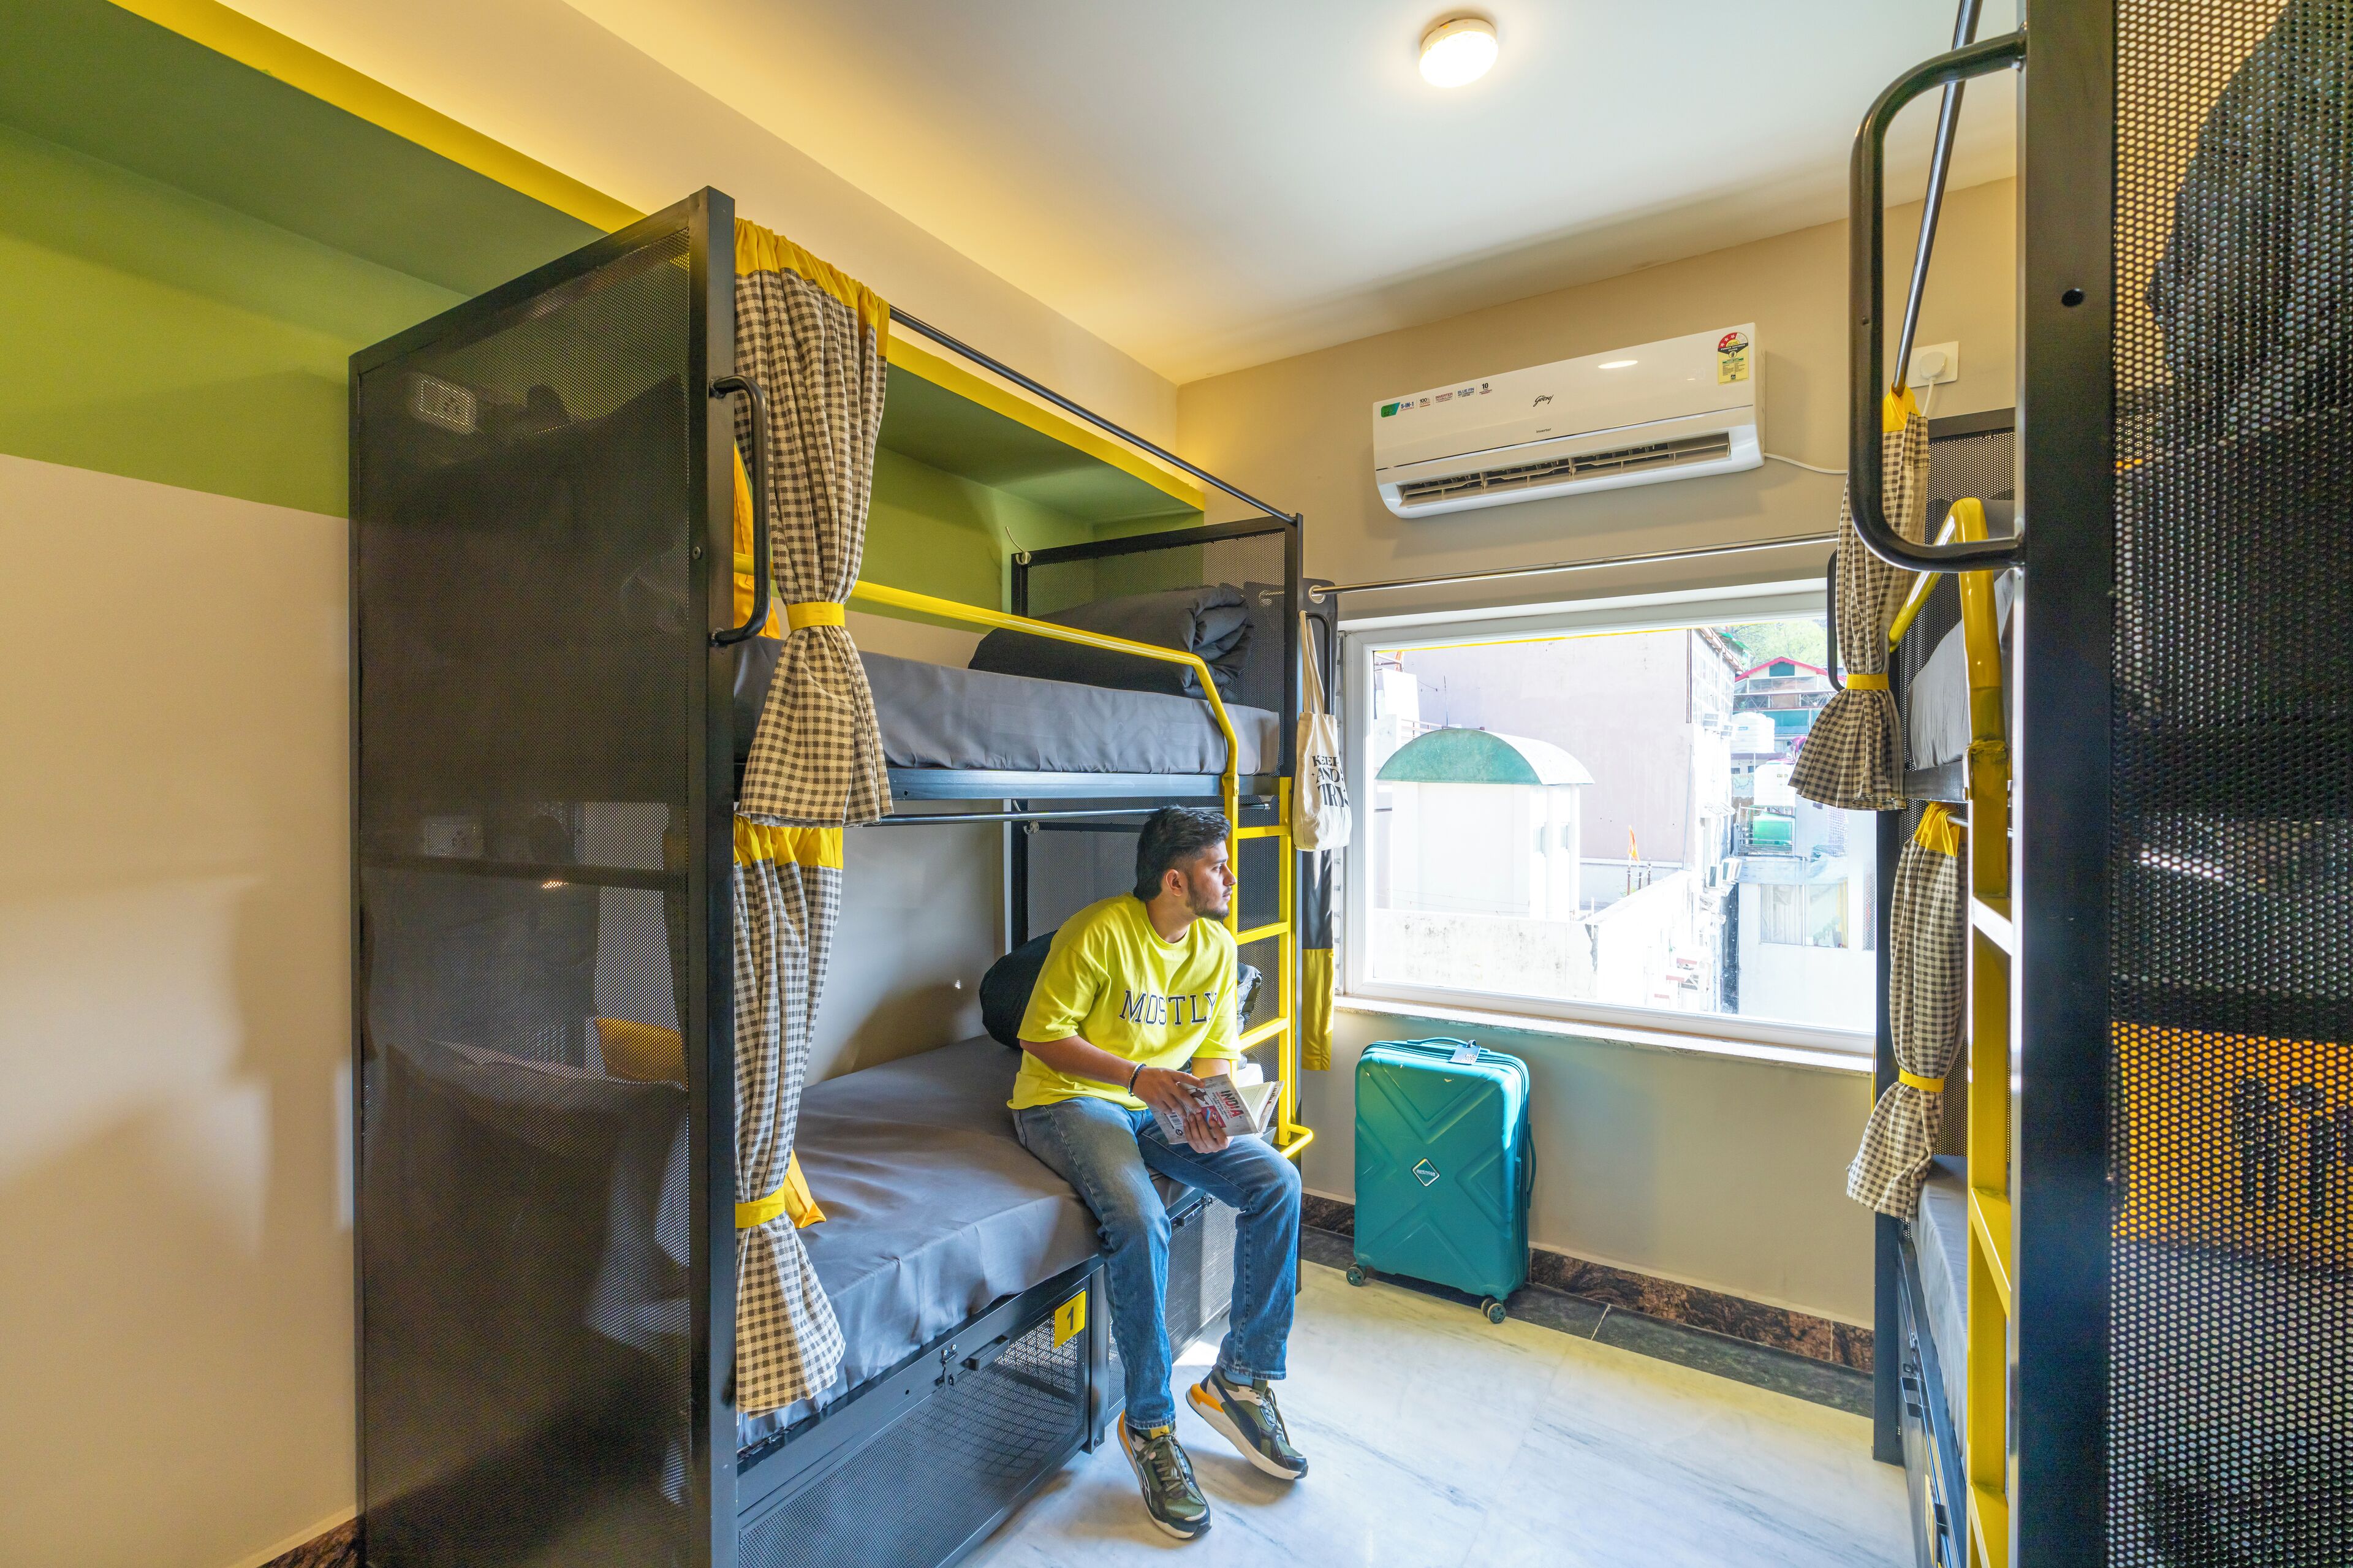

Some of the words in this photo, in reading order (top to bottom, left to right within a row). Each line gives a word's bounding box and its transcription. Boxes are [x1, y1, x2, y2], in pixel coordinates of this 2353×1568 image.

[1533, 394, 1554, 407] Godrej
[1316, 767, 1340, 784] AND
[1119, 990, 1217, 1026] MOSTLY
[1220, 1090, 1245, 1118] INDIA
[1067, 1306, 1074, 1331] 1
